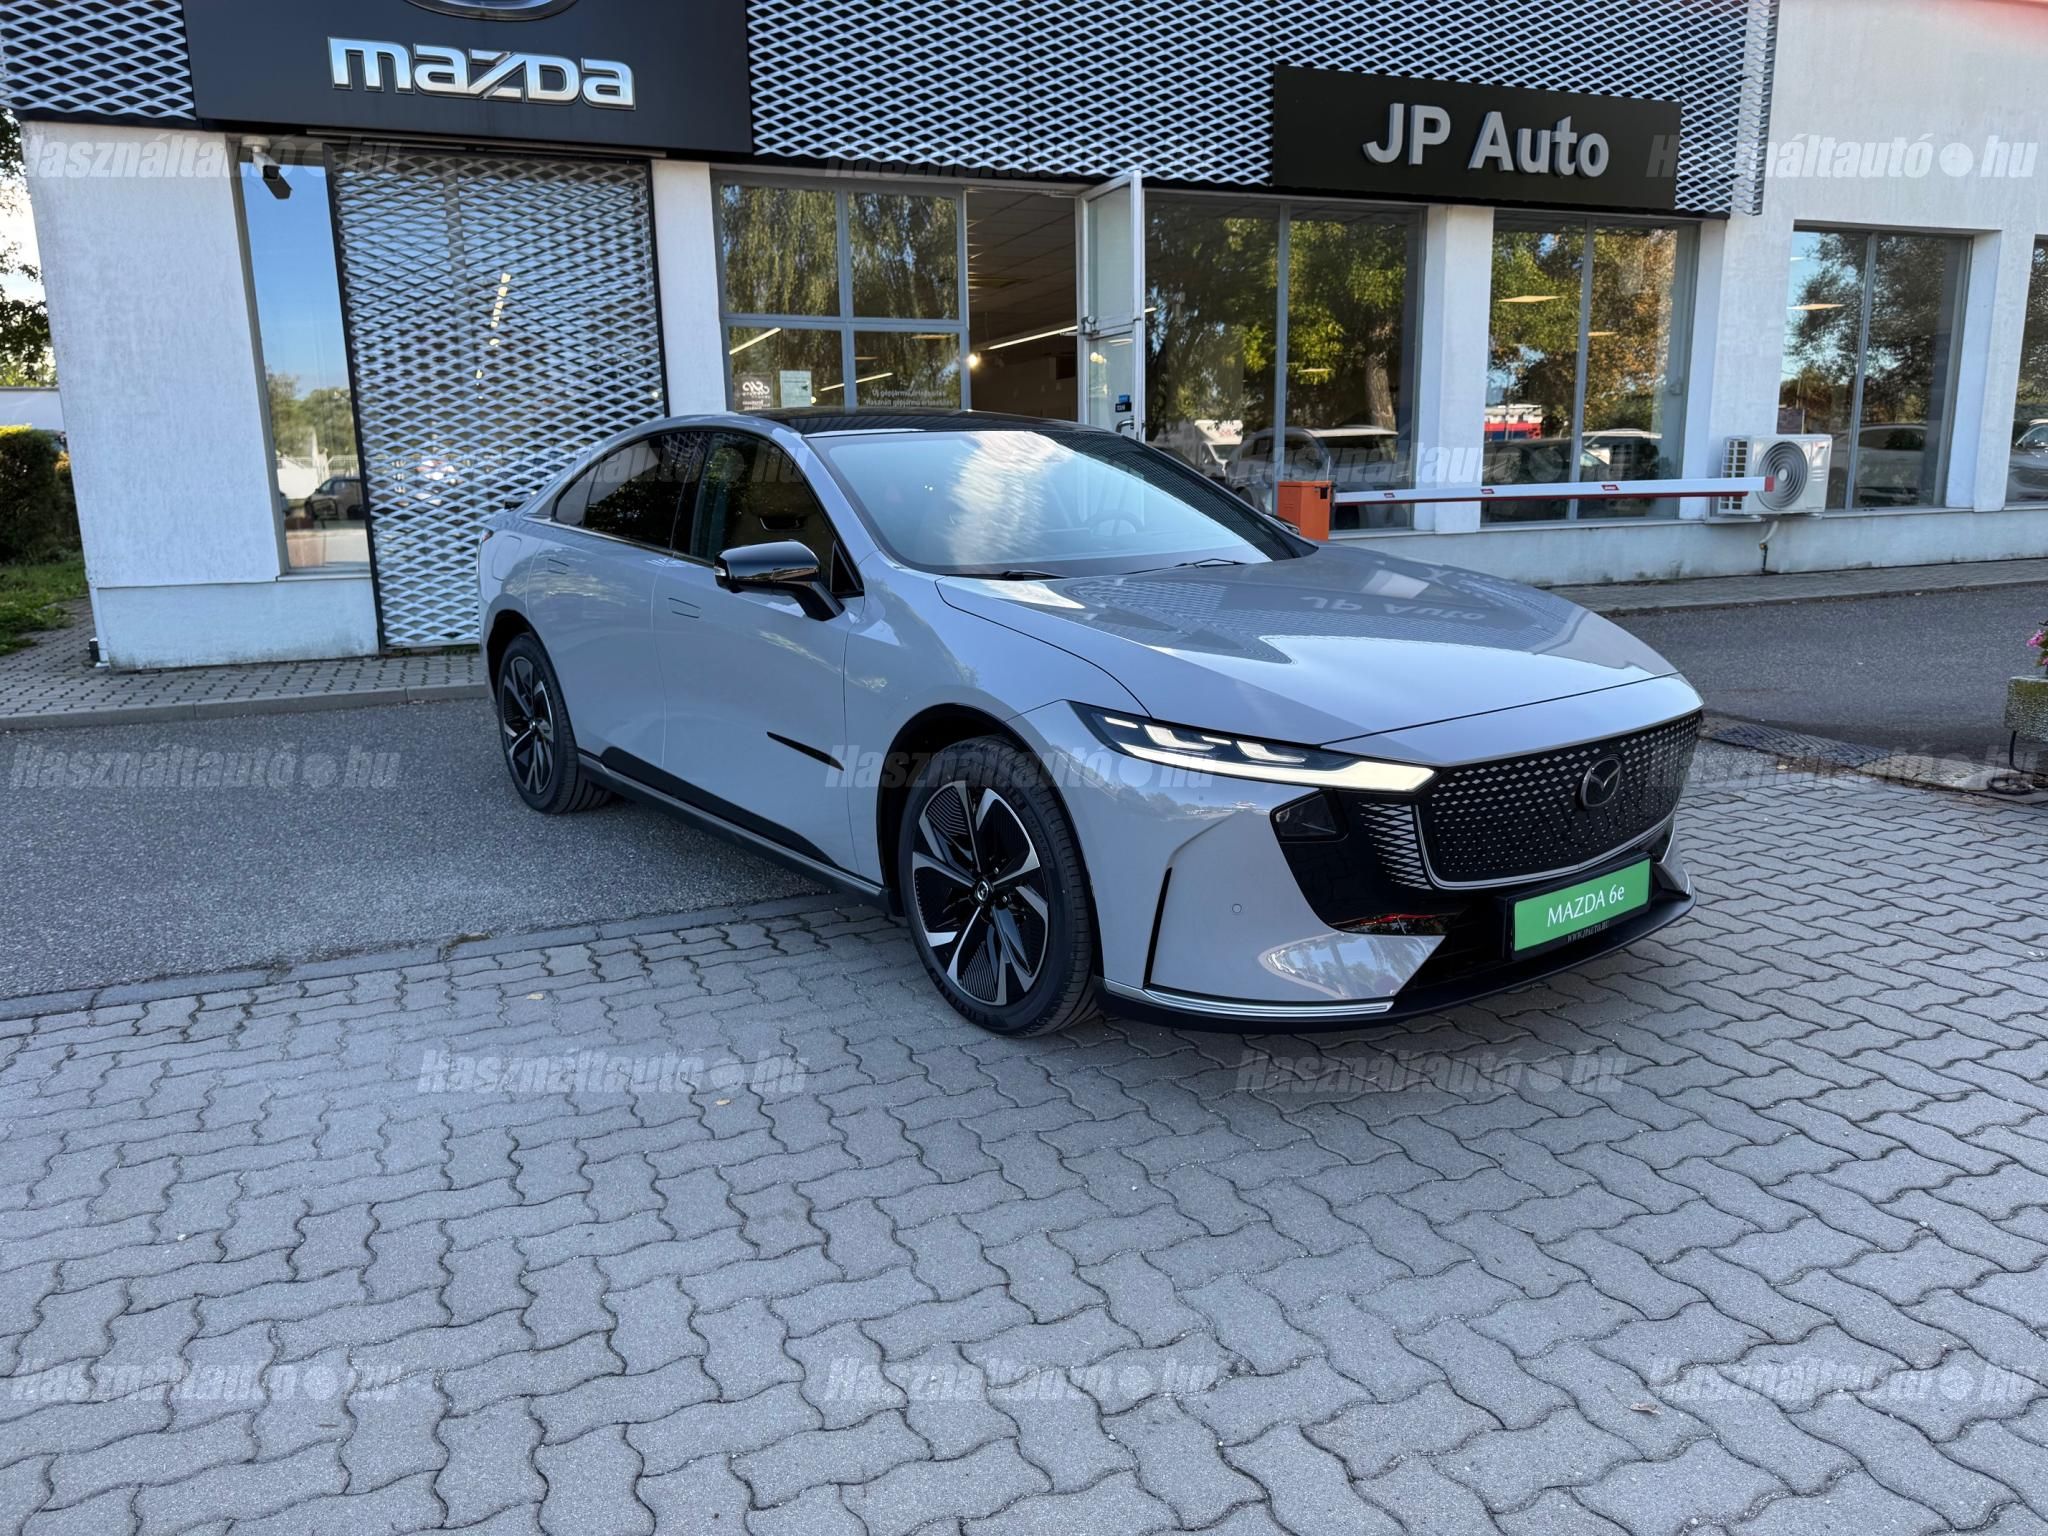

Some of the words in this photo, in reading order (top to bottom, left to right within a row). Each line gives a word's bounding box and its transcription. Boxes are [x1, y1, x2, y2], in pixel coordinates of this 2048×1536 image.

[1362, 102, 1451, 166] JP
[1467, 110, 1610, 178] Auto
[1547, 889, 1606, 928] MAZDA
[1609, 883, 1625, 904] 6e
